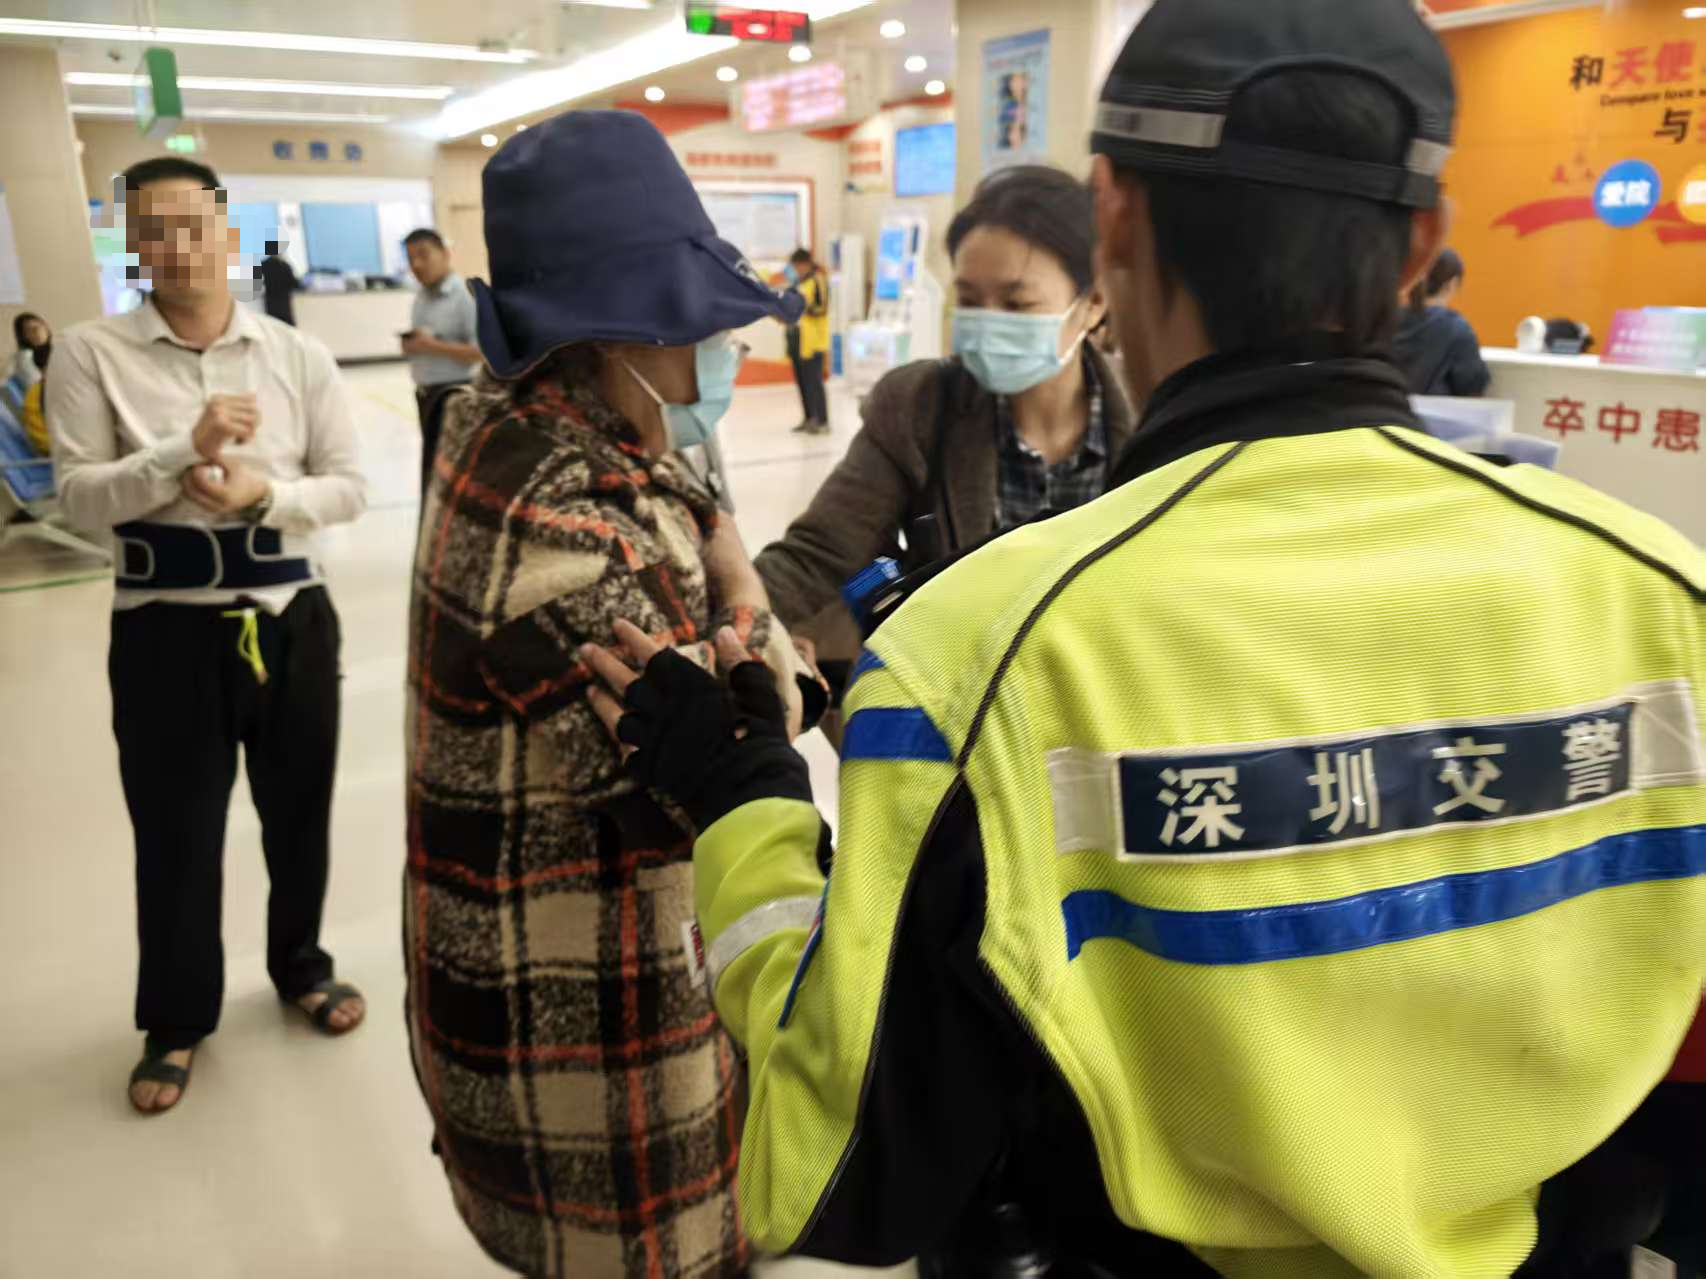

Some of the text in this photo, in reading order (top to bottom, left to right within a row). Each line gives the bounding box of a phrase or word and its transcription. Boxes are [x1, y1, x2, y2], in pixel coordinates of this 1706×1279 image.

[1570, 41, 1706, 90] 和天使
[1653, 108, 1706, 144] 与
[1543, 396, 1701, 453] 卒中患
[1157, 718, 1622, 848] 深圳交警
